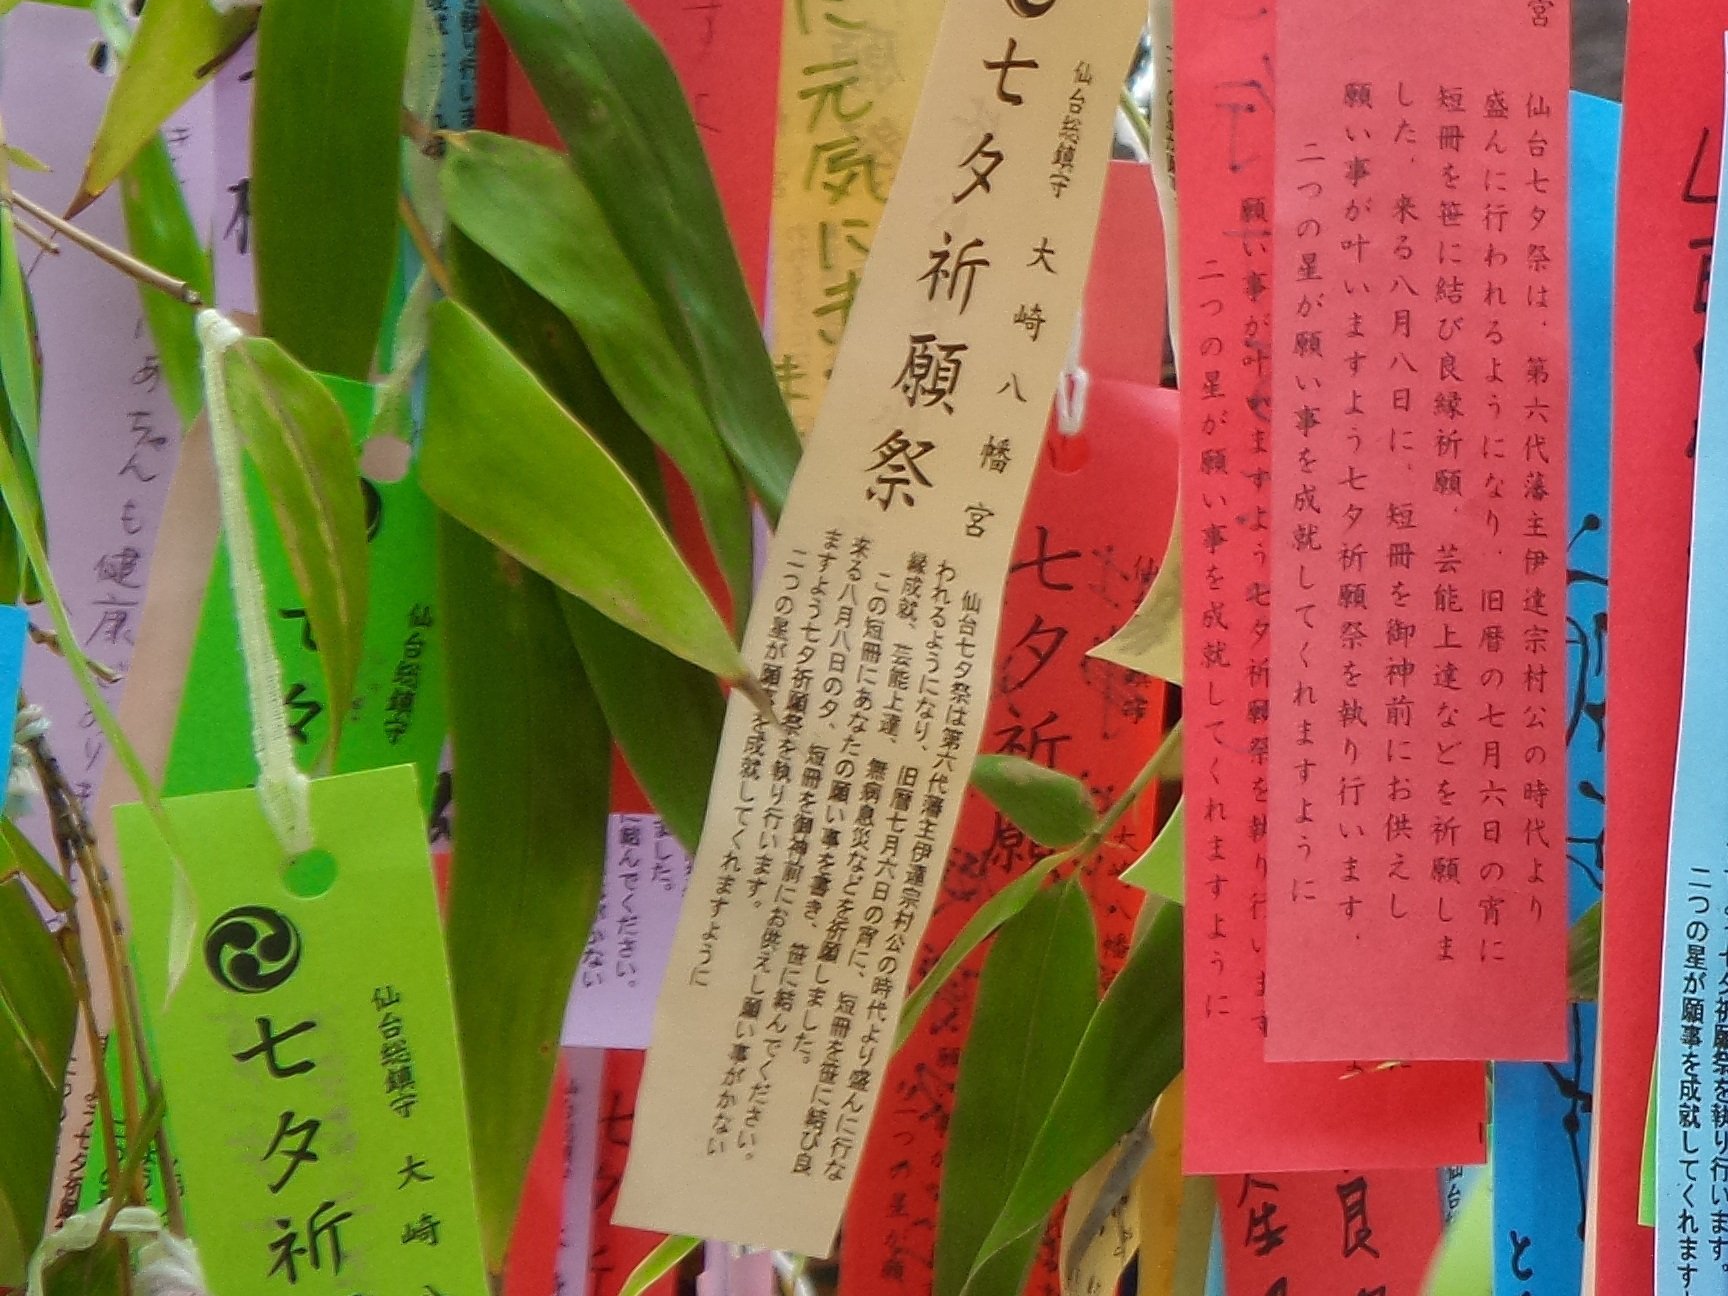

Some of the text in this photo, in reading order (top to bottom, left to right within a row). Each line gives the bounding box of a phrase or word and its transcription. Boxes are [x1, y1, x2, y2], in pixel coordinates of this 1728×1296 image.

[864, 38, 1040, 511] 七夕祈願祭
[963, 60, 1094, 537] 仙台総鎮守 大崎八幡宮
